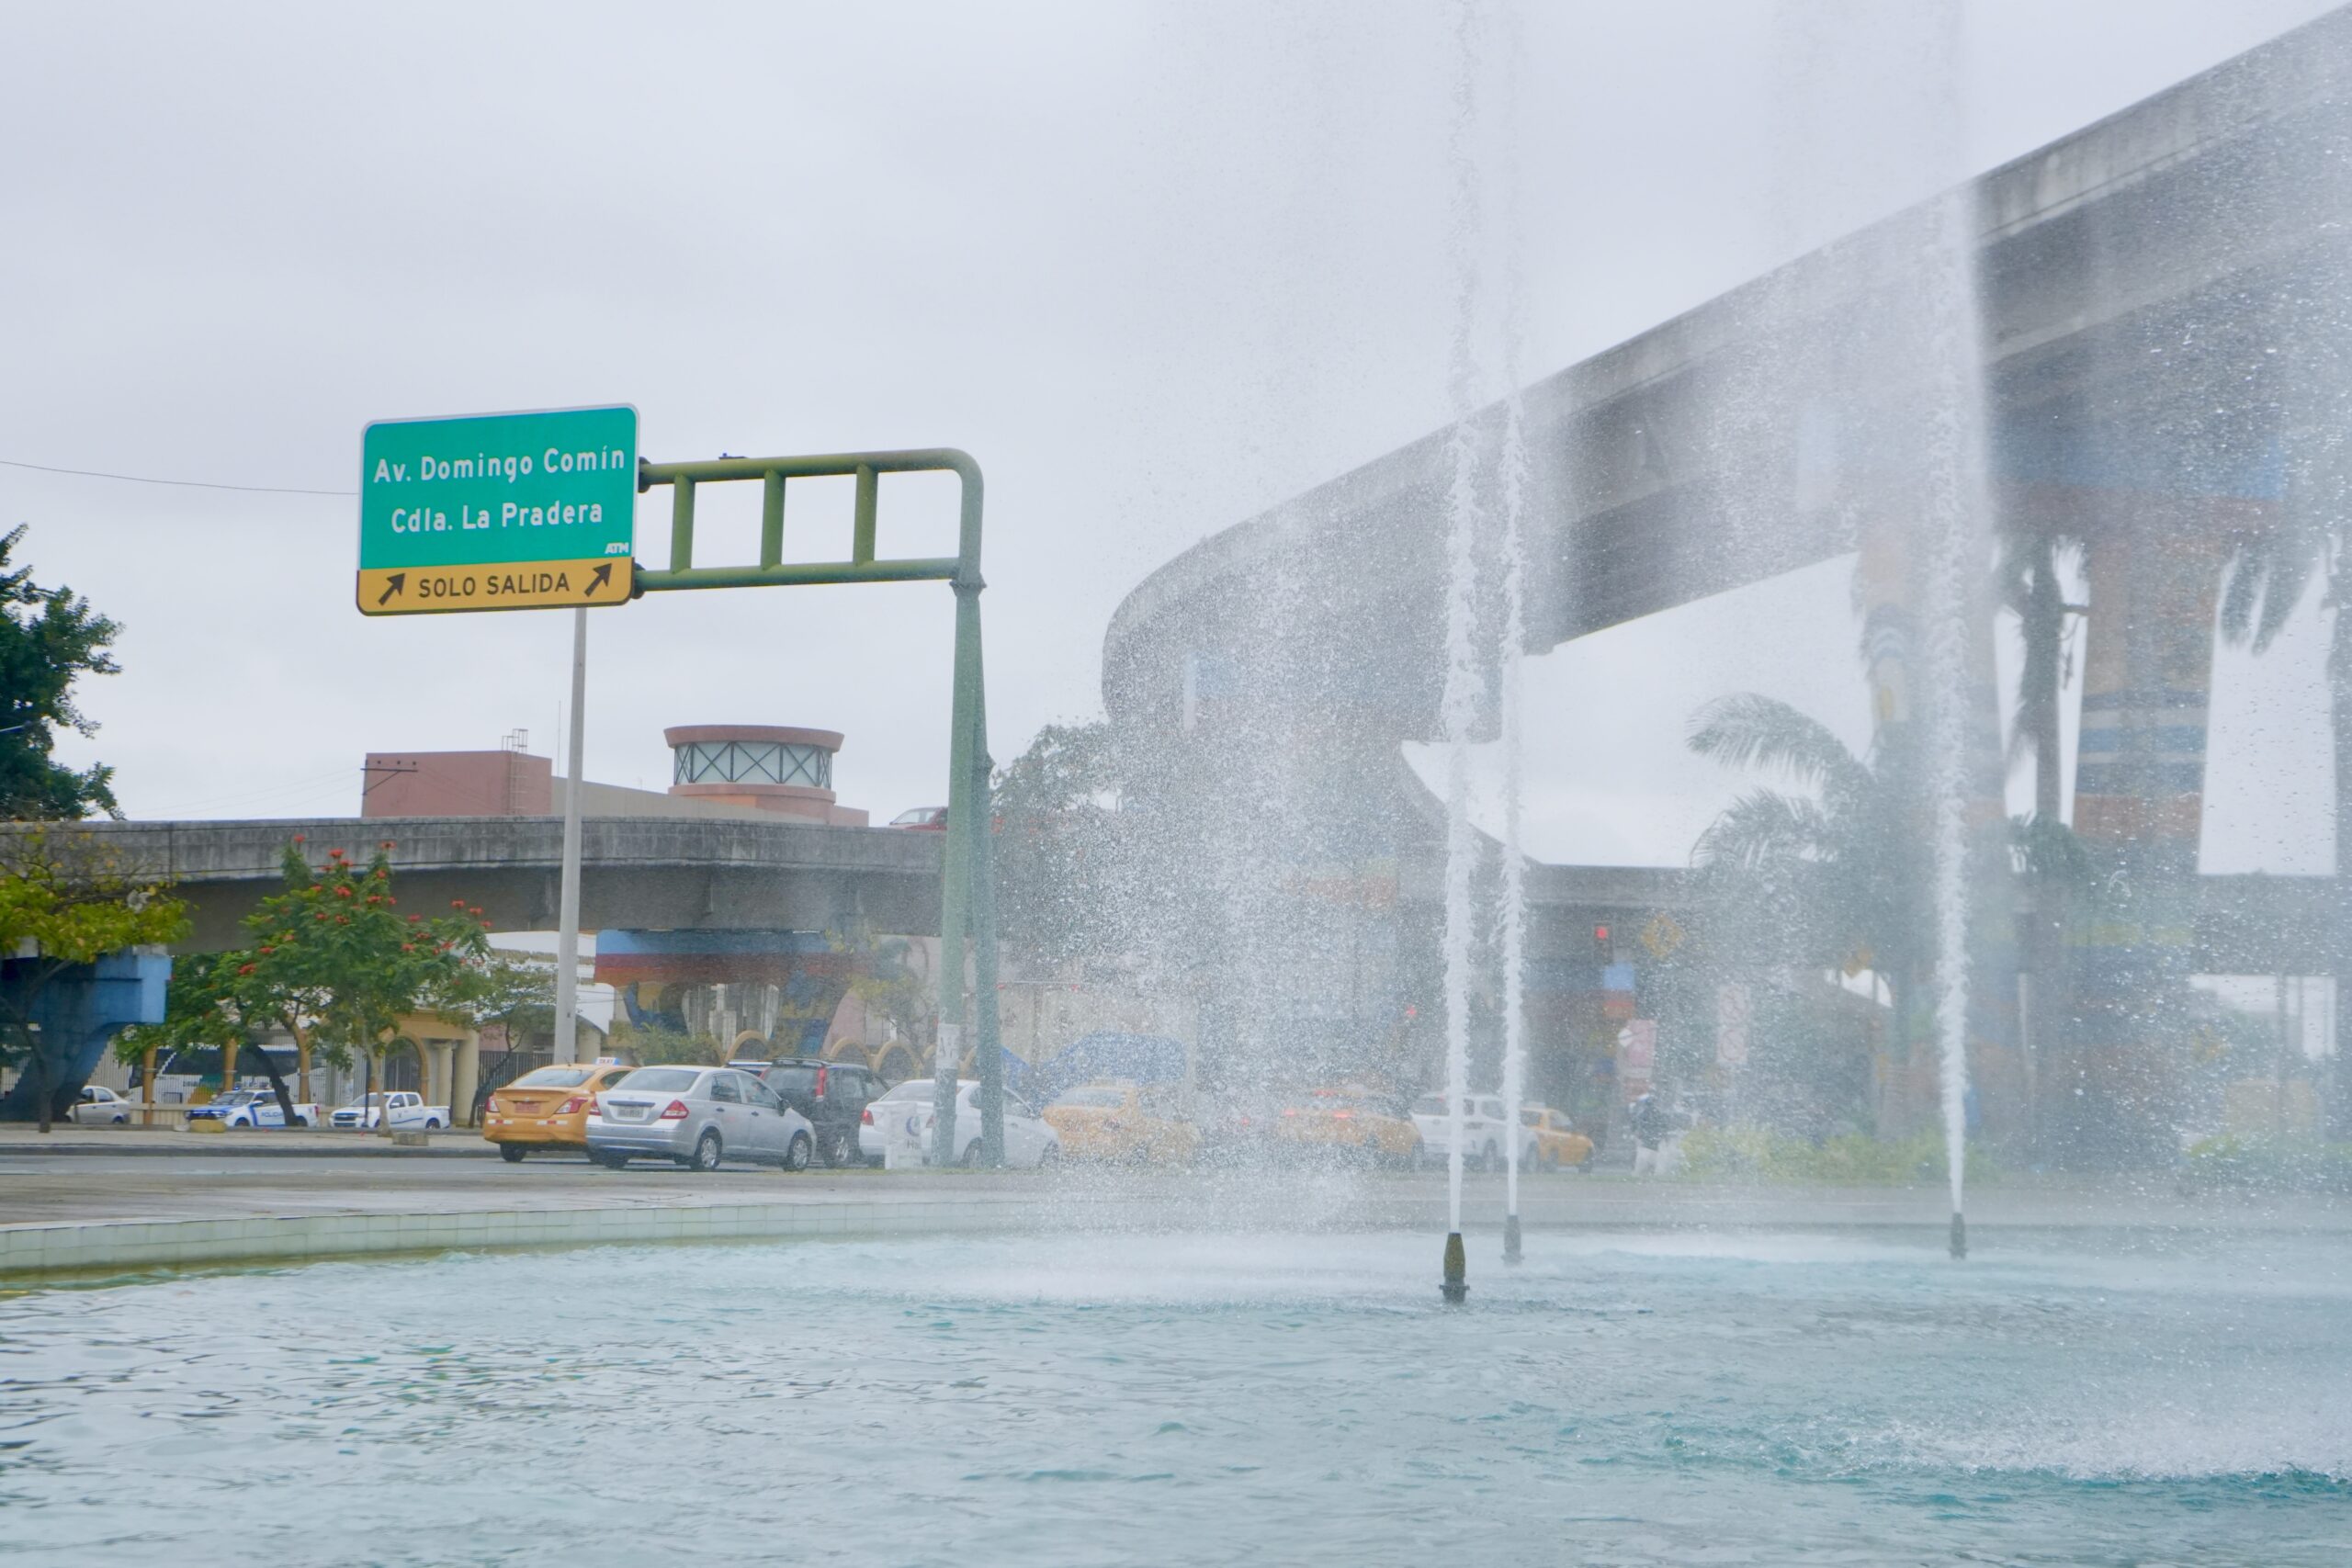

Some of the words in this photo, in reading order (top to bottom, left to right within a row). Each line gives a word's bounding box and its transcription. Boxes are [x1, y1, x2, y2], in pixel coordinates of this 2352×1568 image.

[373, 458, 412, 483] Av.
[420, 453, 533, 484] Domingo
[543, 446, 626, 474] Comín
[390, 508, 453, 533] Cdla.
[462, 505, 490, 530] La
[502, 501, 603, 527] Pradera
[605, 542, 629, 555] ATM
[418, 577, 476, 598] SOLO
[486, 572, 571, 596] SALIDA
